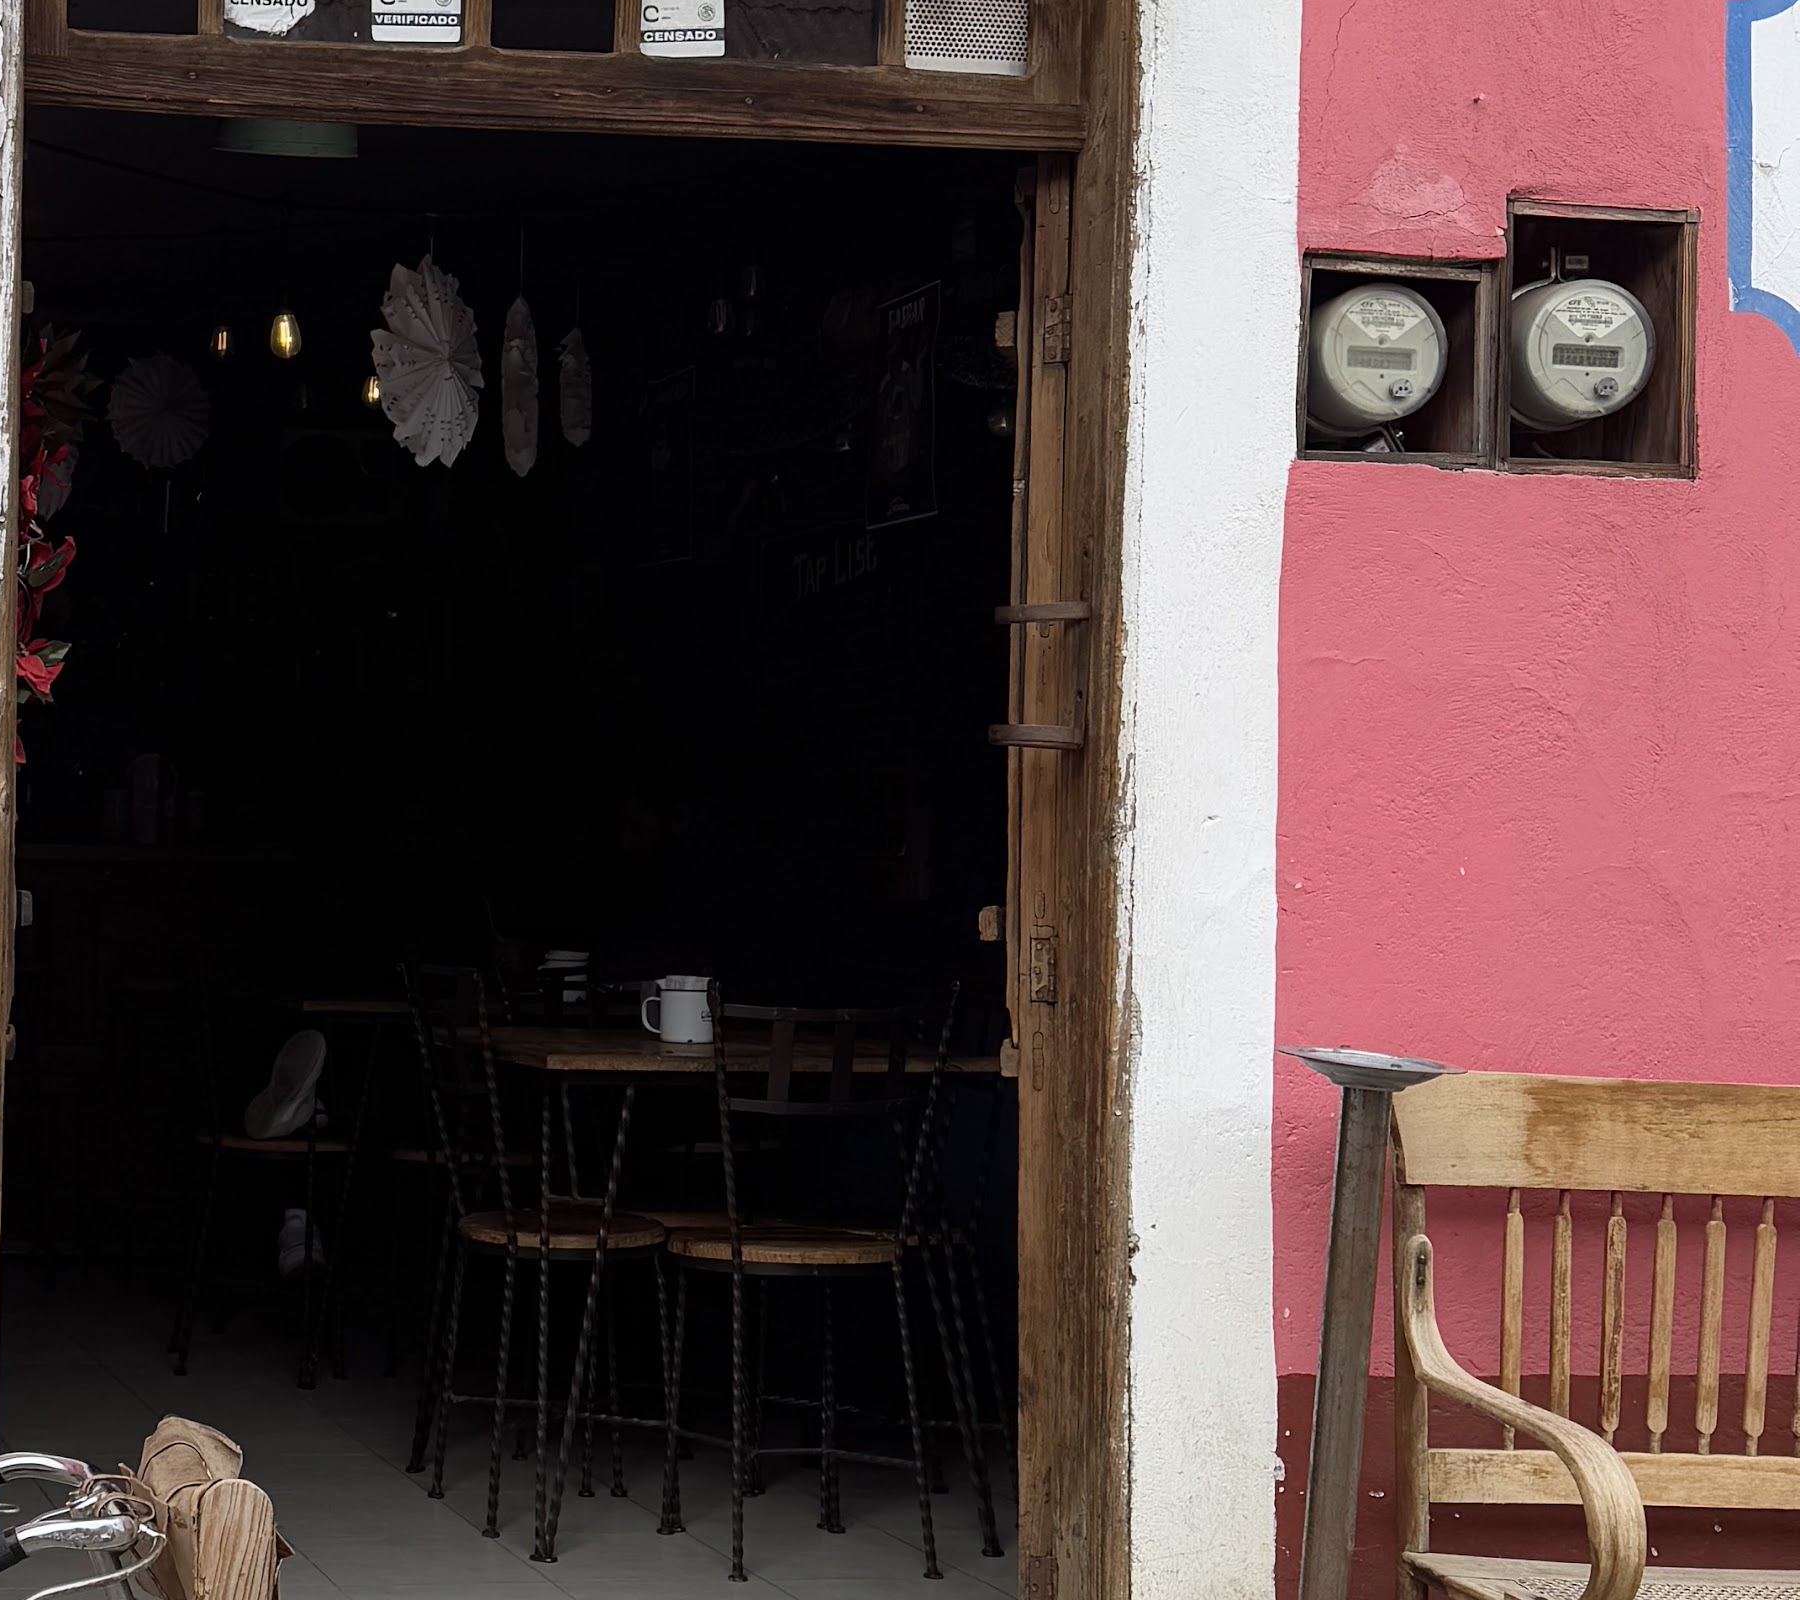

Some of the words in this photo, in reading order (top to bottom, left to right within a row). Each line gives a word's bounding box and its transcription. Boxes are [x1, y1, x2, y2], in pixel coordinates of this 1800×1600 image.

[374, 13, 459, 26] VERIFICADO
[643, 30, 717, 43] CENSADO
[792, 552, 826, 599] TAP
